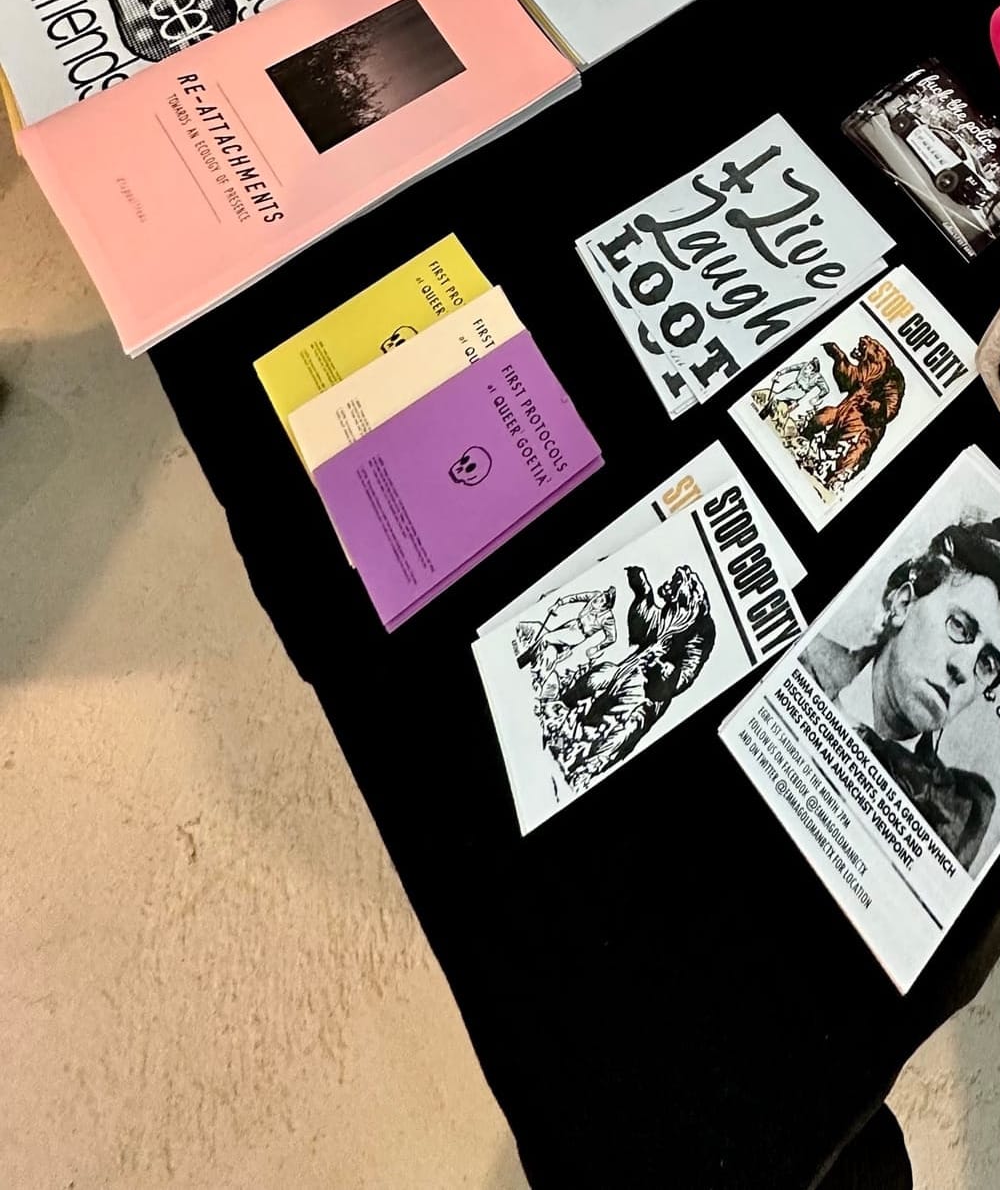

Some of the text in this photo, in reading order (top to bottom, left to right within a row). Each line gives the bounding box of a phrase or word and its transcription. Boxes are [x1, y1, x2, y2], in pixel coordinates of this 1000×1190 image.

[177, 73, 284, 224] RE-ATTACHMENTS
[918, 74, 954, 103] fuck
[948, 98, 968, 121] the
[956, 121, 998, 153] police
[163, 92, 251, 223] TOWARDS AN ECOLOGY OF PRESENCE
[428, 260, 450, 286] FIRST
[633, 174, 817, 345] Laugh
[725, 168, 846, 290] Live
[472, 318, 496, 349] FIRST
[597, 223, 741, 389] LOOT
[867, 280, 969, 389] STOP COP CITY
[500, 363, 568, 474] FIRST PROTOCOLS
[703, 486, 802, 655] STOP COP CITY
[747, 716, 771, 747] FOLLOW
[766, 741, 777, 755] US
[772, 750, 785, 766] ON
[780, 760, 809, 799] FACEBOOK
[773, 687, 915, 872] MOVIES FROM AN ANARCHIST VIEWPOINT.
[777, 732, 805, 768] SATURDAY
[801, 763, 813, 778] OF
[808, 773, 822, 790] THE
[817, 786, 840, 815] MONTH
[835, 810, 851, 830] 7PM
[782, 677, 923, 860] DISCUSSES CURRENT EVENTS, BOOKS AND
[791, 668, 815, 698] EMMA
[811, 693, 849, 741] GOLDMAN
[845, 736, 870, 768] BOOK
[866, 763, 889, 792] CLUB
[885, 787, 897, 802] IS
[900, 806, 930, 845] GROUP
[926, 839, 956, 879] WHICH
[738, 727, 753, 746] AND
[748, 741, 761, 757] ON
[755, 751, 779, 783] TWITTER
[830, 854, 846, 875] FOR
[841, 869, 872, 911] LOCATION
